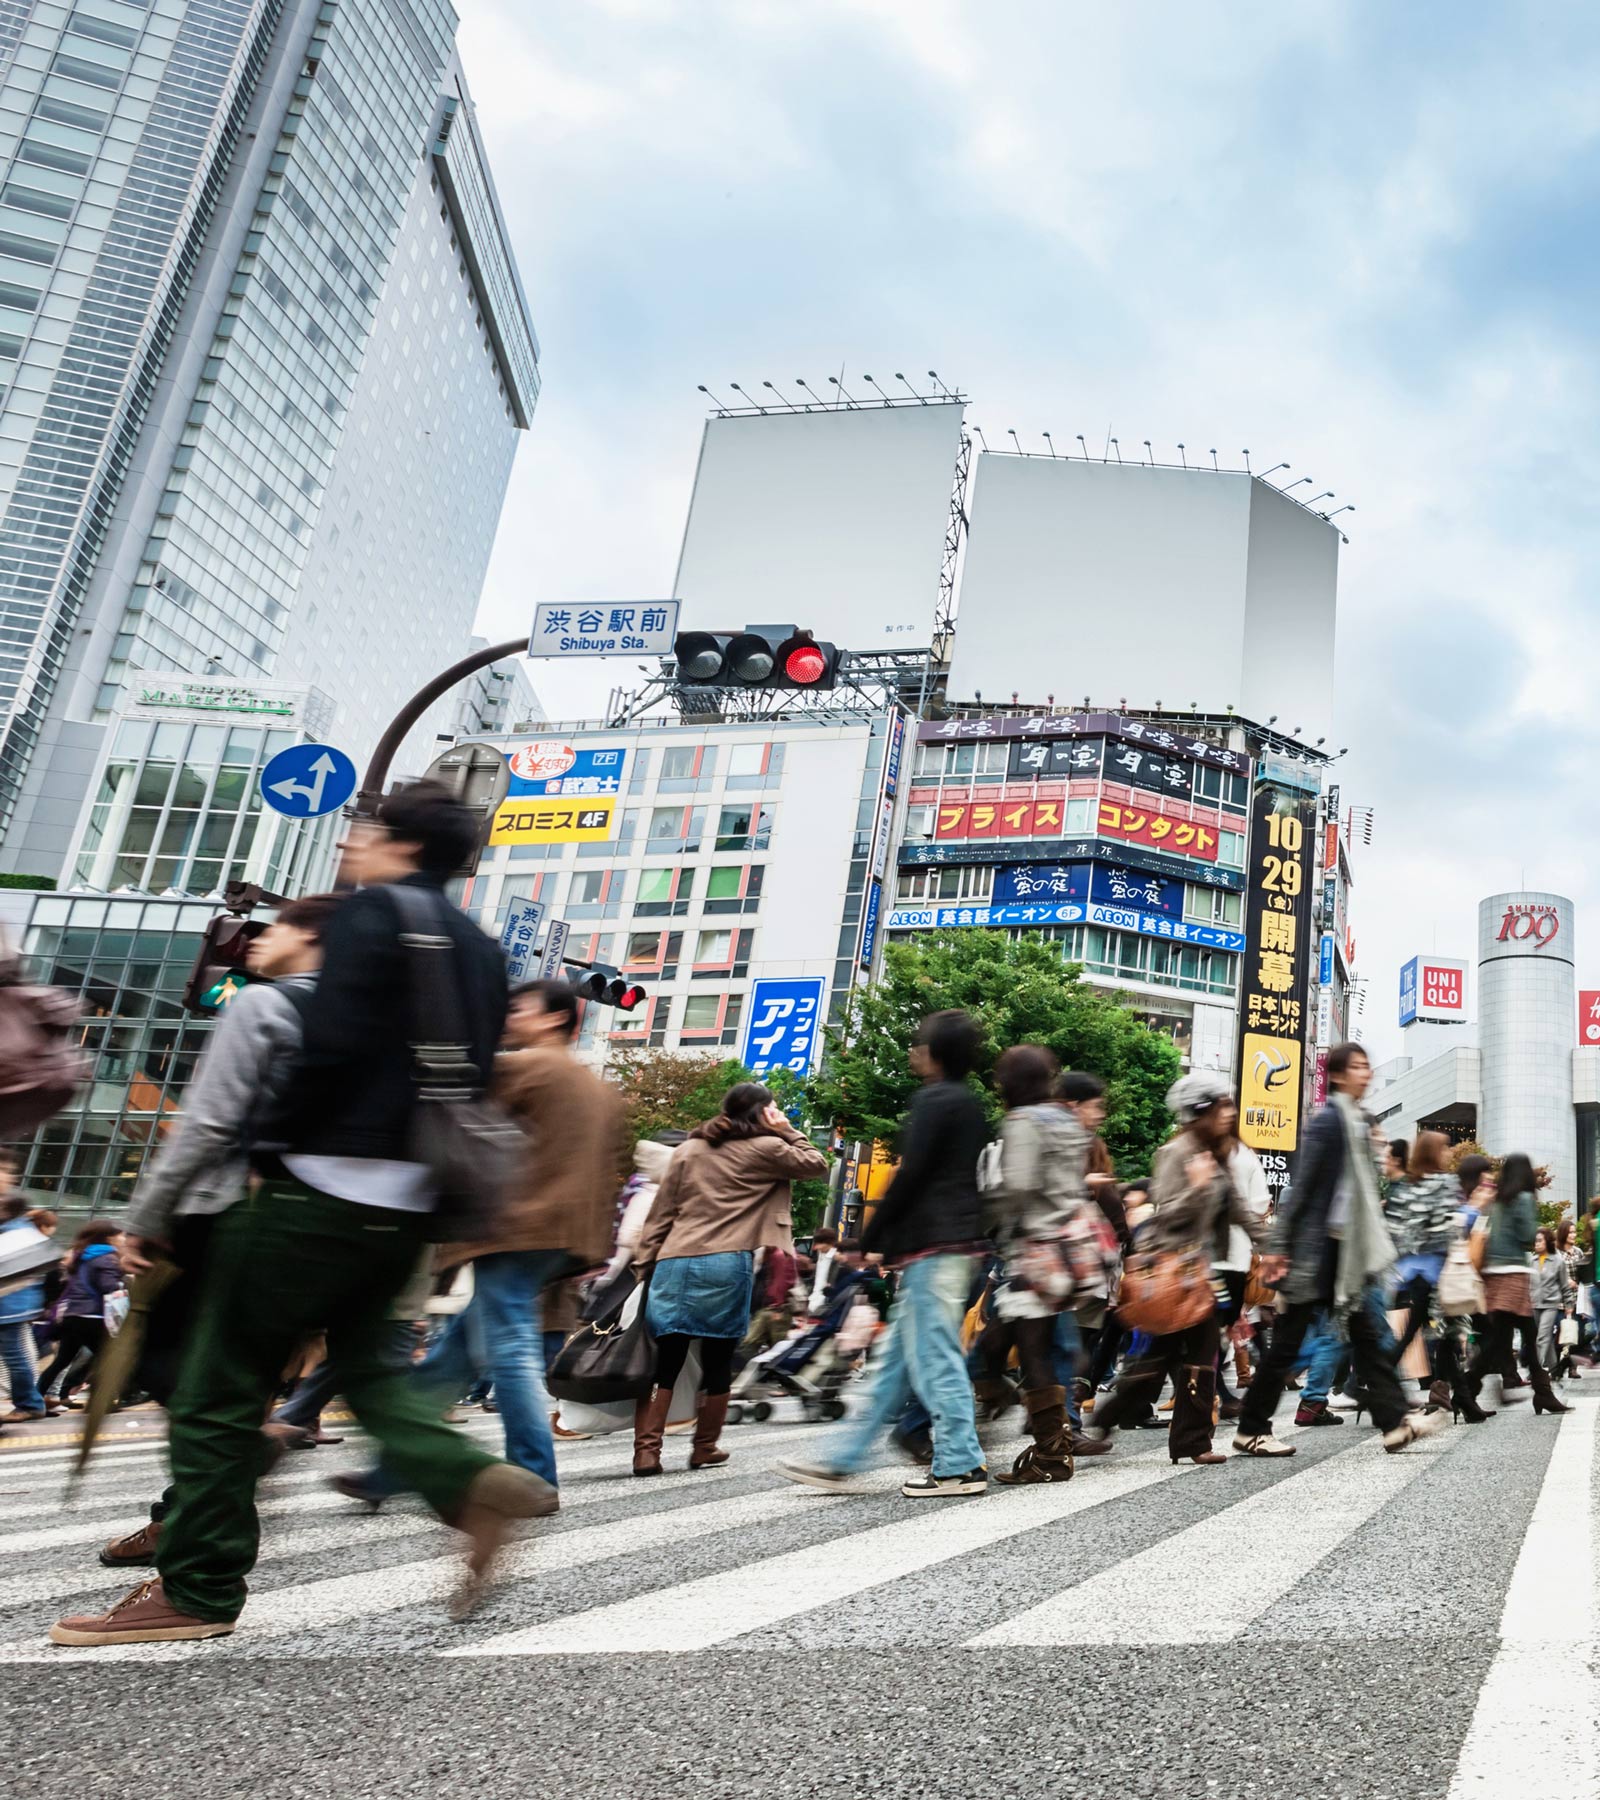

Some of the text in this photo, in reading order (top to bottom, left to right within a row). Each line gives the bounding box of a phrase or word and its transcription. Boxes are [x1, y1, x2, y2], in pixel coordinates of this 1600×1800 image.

[544, 608, 667, 633] 渋谷駅前
[560, 636, 648, 651] Shibuya Sta.
[142, 689, 294, 709] MARK CITY
[561, 776, 619, 793] 武富士
[496, 811, 605, 832] プロミス 4F
[939, 803, 1215, 851] プライス コンタクト
[1075, 844, 1088, 854] 7F
[1100, 845, 1113, 856] 7F
[1261, 855, 1303, 897] 29
[889, 911, 932, 926] AEON
[941, 907, 1077, 925] 英会話イーオン 6F
[1093, 908, 1136, 928] AEON
[1507, 904, 1557, 914] SHIBUYA
[1142, 916, 1242, 948] 英会話イーオン
[1496, 911, 1559, 949] 109
[507, 907, 539, 977] 渋谷駅前
[1257, 910, 1297, 992] 開幕
[1427, 971, 1456, 988] UNI
[1248, 994, 1301, 1017] 日本 VS
[1427, 988, 1459, 1006] QLO
[1248, 1013, 1300, 1035] ポーランド
[1246, 1107, 1292, 1128] 世界バレー
[1256, 1128, 1280, 1138] JAPAN
